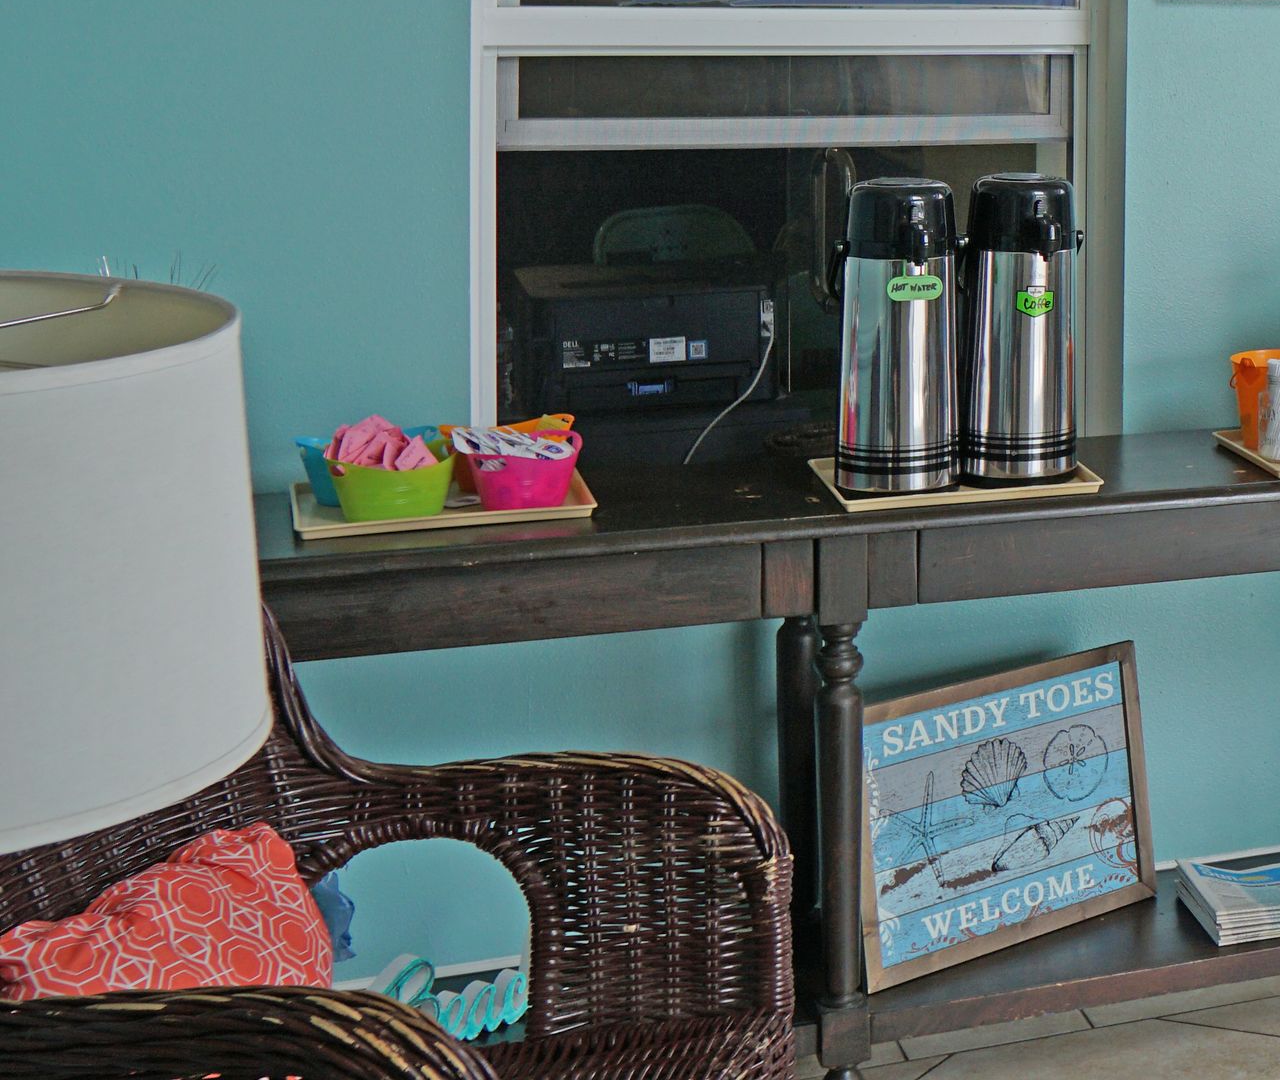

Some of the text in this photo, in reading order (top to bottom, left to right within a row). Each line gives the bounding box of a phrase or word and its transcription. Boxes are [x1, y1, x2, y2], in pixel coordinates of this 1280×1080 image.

[891, 282, 937, 293] HOT WATER
[563, 340, 578, 348] DELL
[882, 670, 1116, 757] SANDY TOES
[921, 863, 1097, 940] WELCOME
